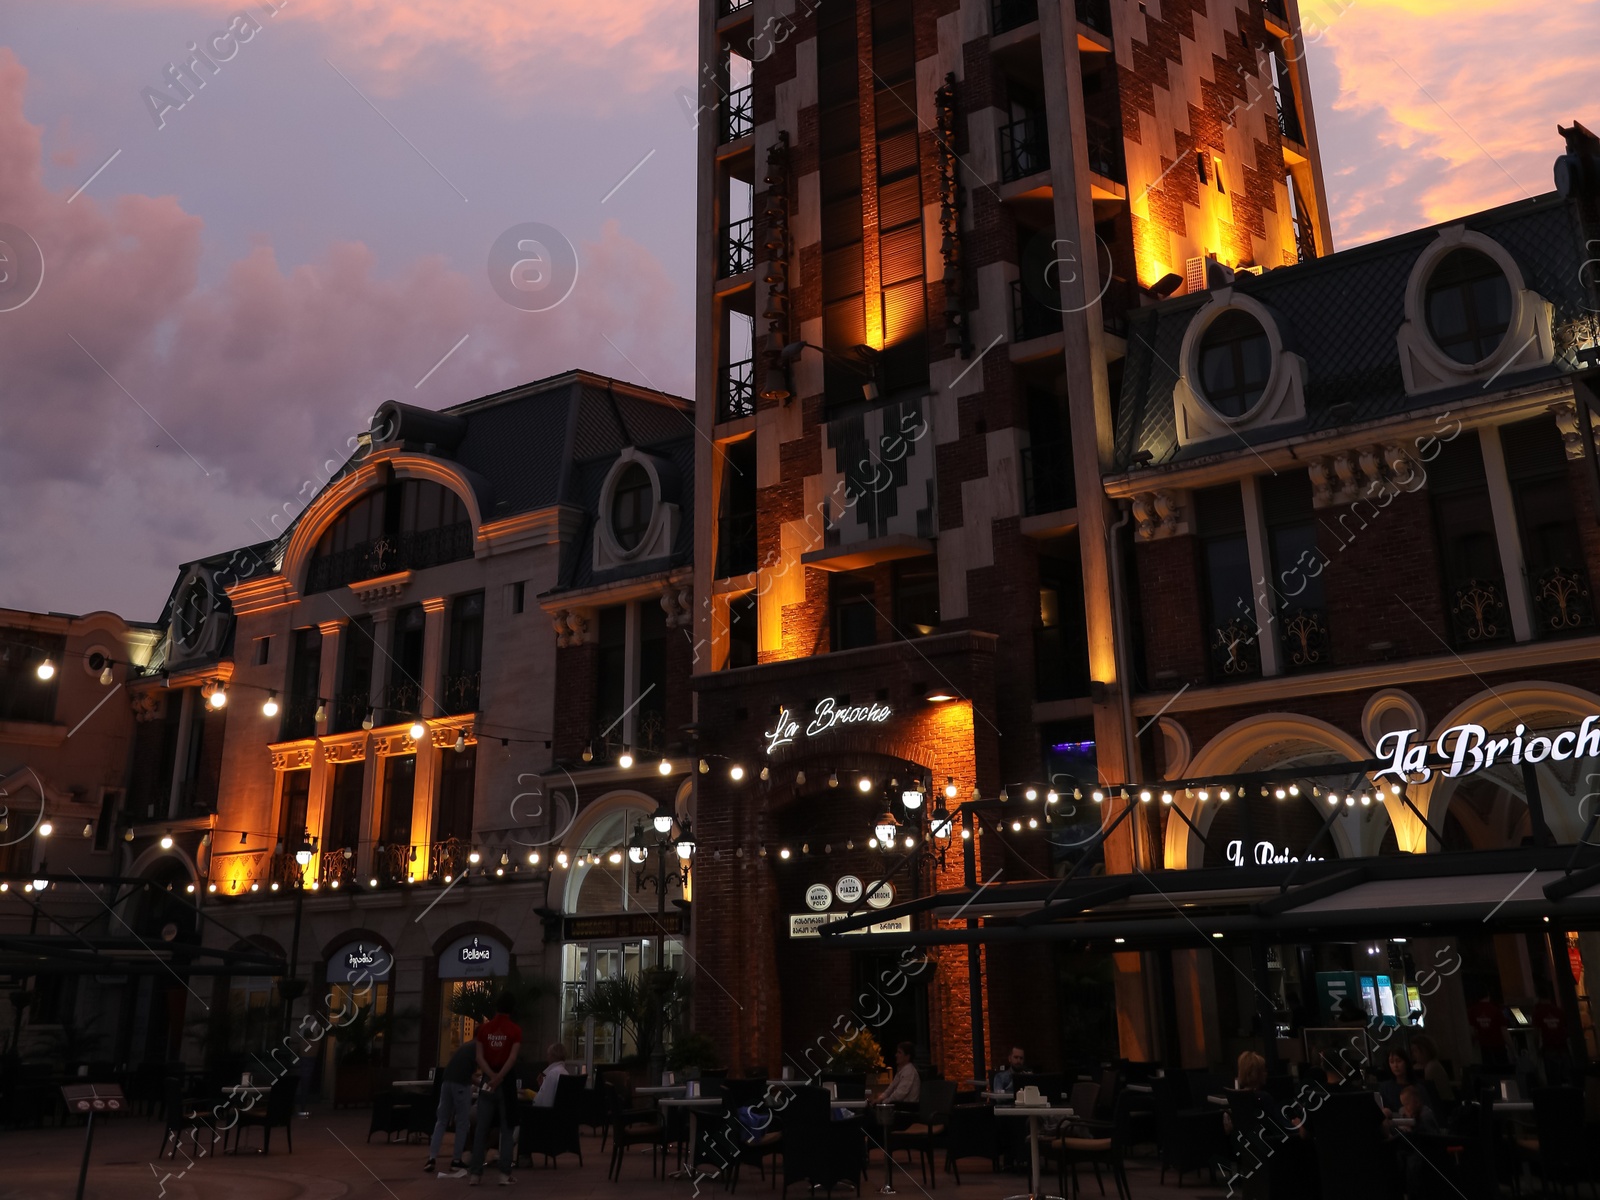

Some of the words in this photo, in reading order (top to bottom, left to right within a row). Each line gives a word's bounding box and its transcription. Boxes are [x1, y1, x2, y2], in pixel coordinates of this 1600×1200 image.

[764, 709, 799, 755] La
[806, 697, 891, 737] Brioche
[1373, 729, 1432, 784] La
[839, 886, 859, 894] PIAZZA
[462, 948, 491, 961] Bellamia
